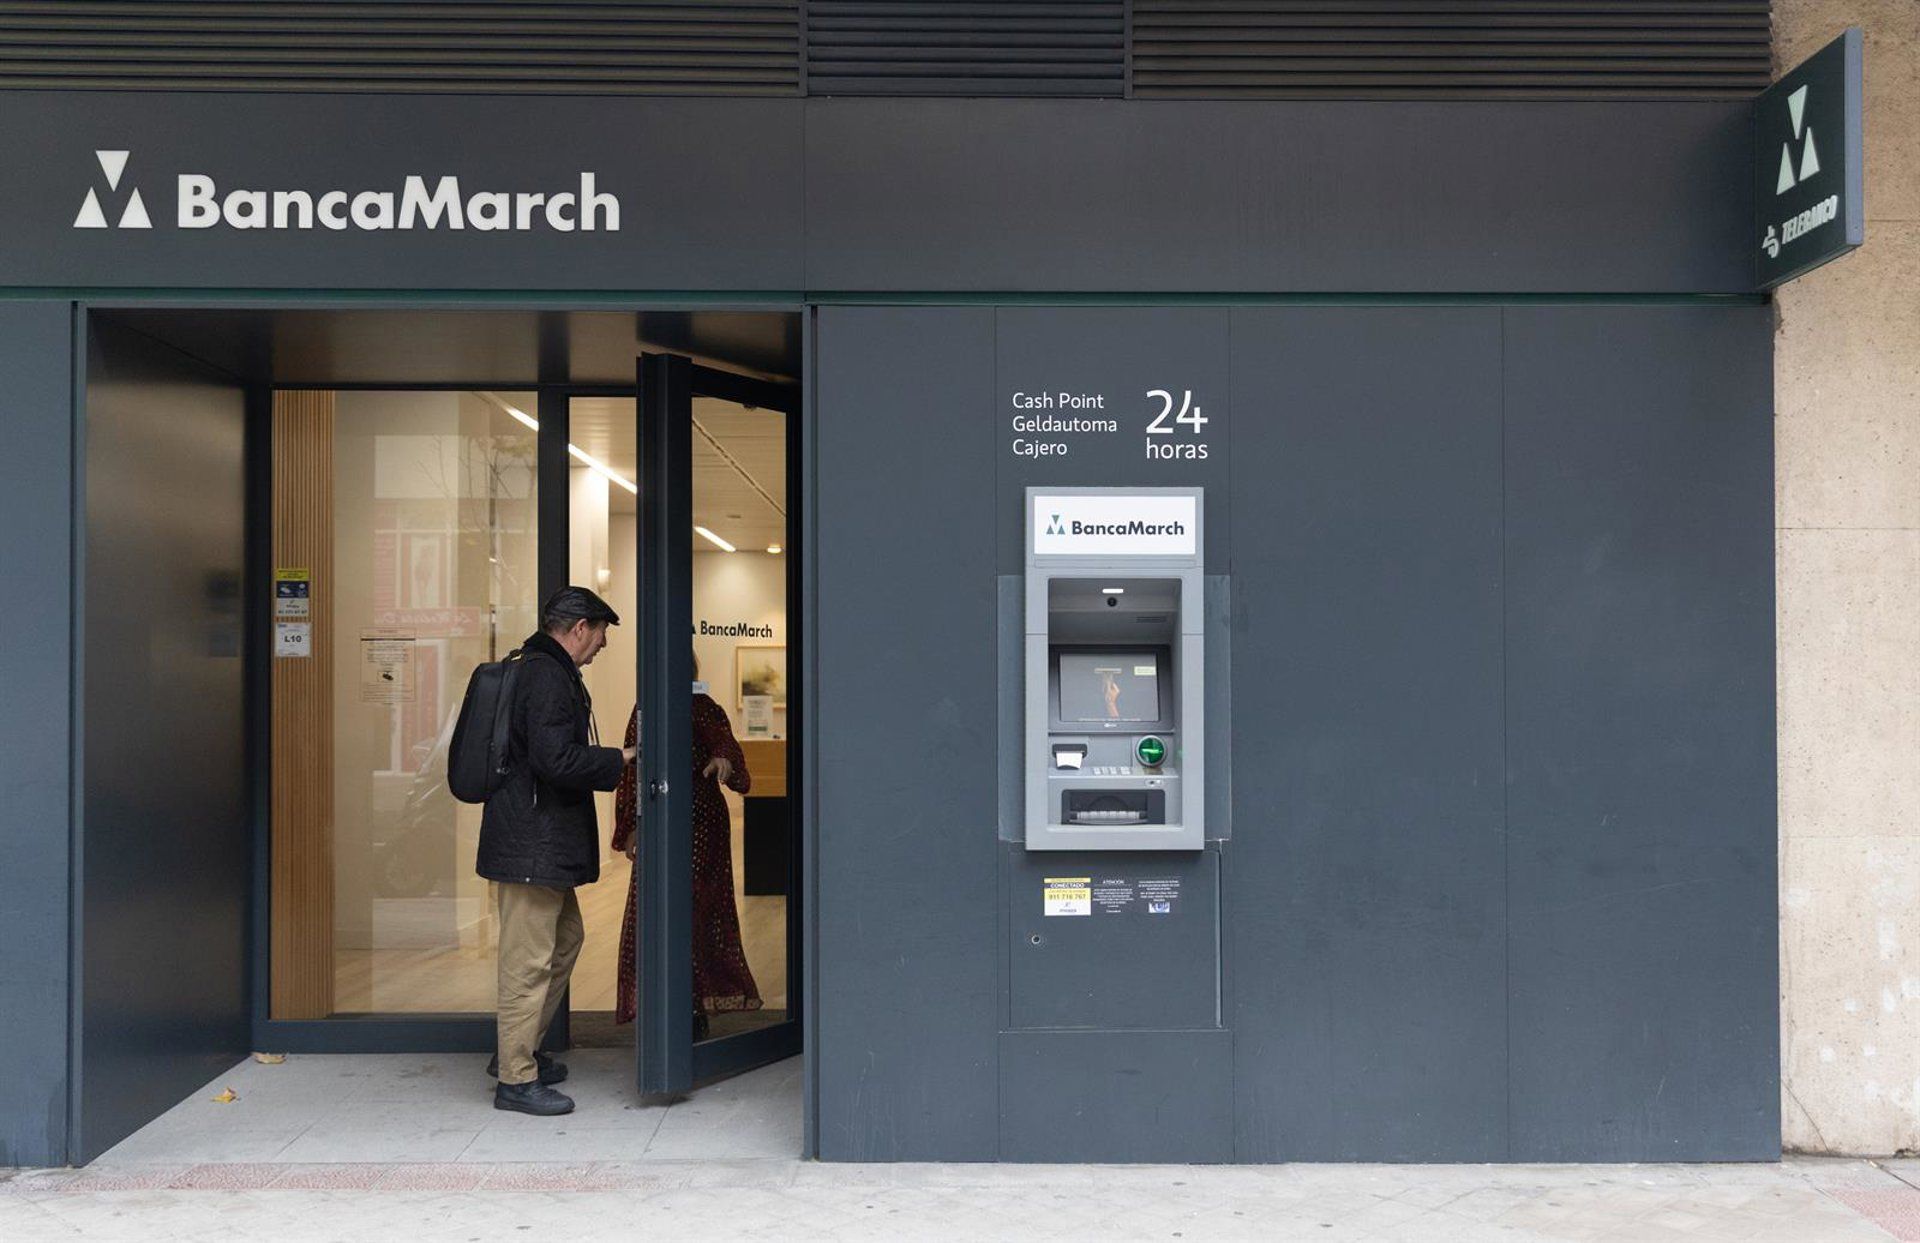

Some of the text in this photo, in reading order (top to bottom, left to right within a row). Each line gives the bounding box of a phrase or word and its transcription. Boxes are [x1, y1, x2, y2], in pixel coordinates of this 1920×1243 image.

[178, 172, 621, 232] BancaMarch
[1012, 392, 1105, 409] Cash Point
[1146, 389, 1209, 434] 24
[1012, 415, 1118, 432] Geldautoma
[1012, 439, 1068, 459] Cajero
[1146, 437, 1209, 459] horas
[1072, 521, 1185, 535] BancaMarch
[700, 620, 773, 638] BancaMarch
[284, 635, 302, 643] L10
